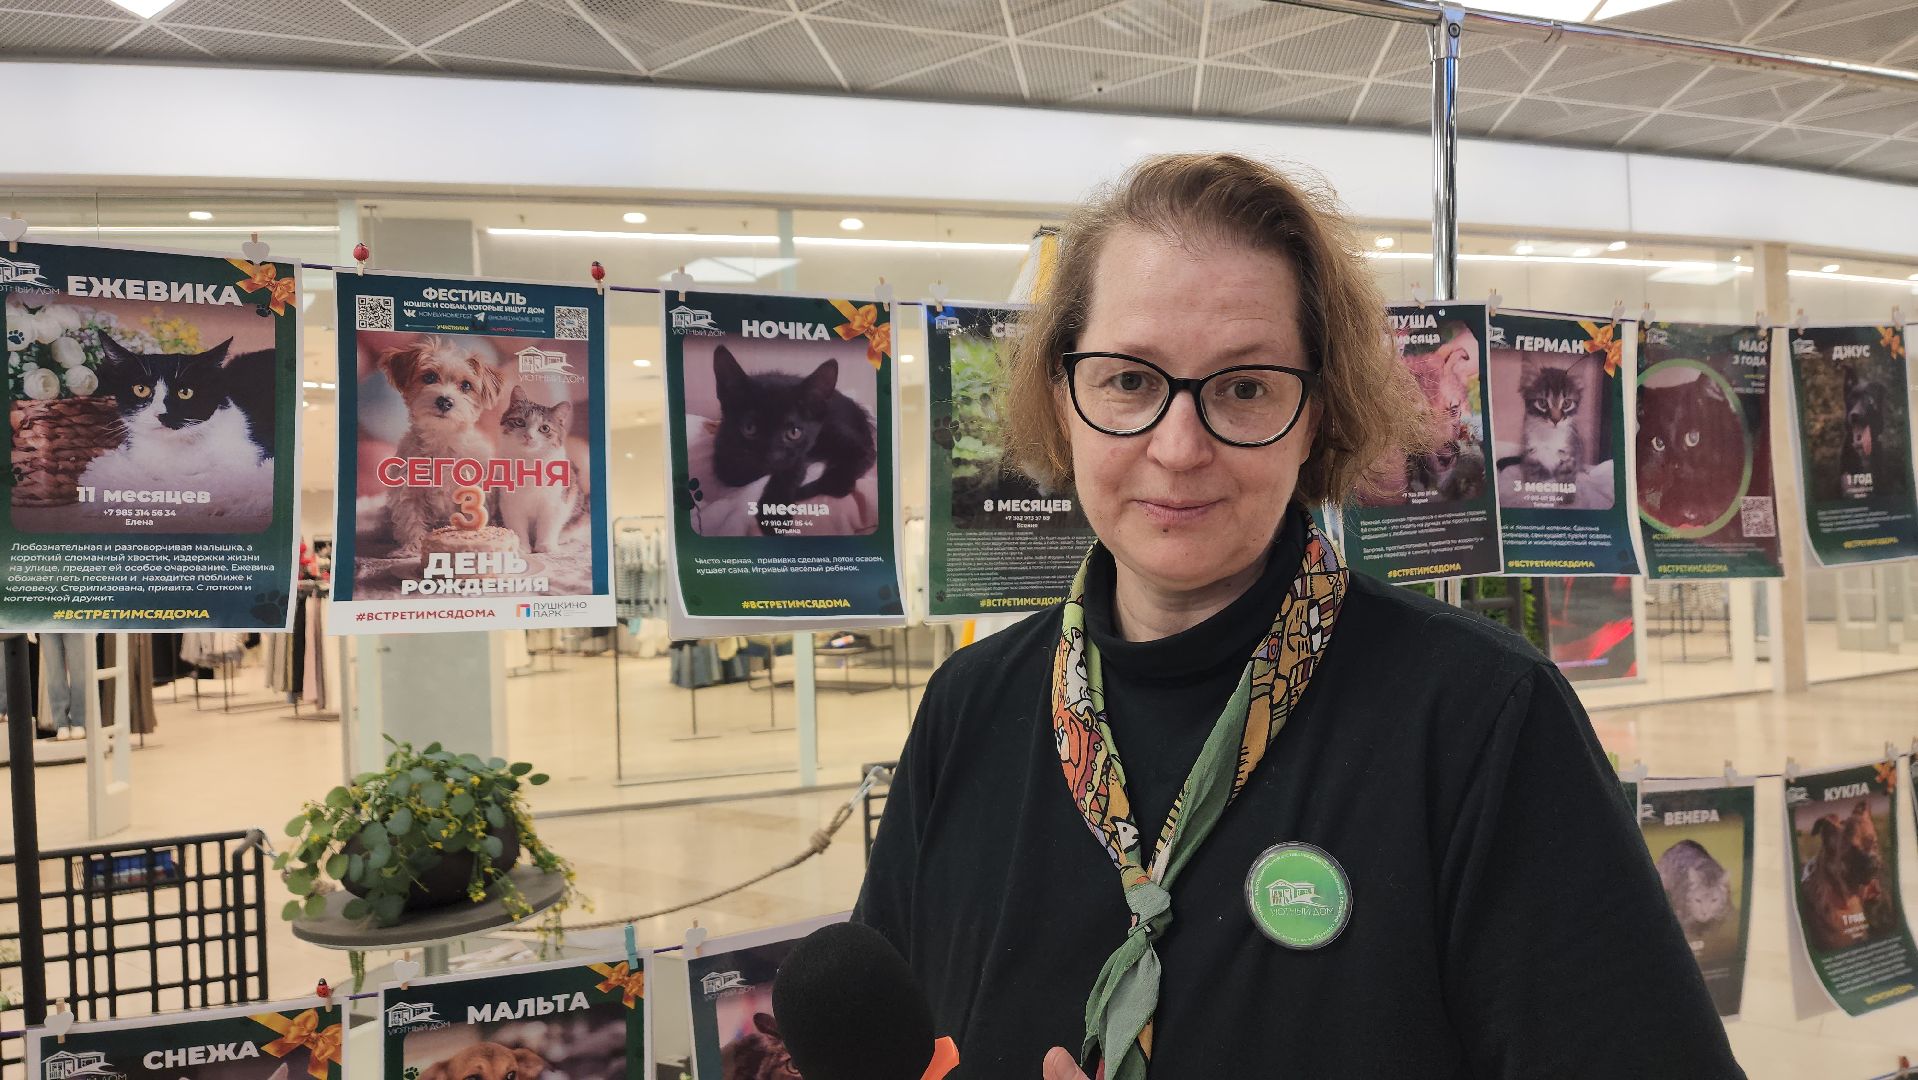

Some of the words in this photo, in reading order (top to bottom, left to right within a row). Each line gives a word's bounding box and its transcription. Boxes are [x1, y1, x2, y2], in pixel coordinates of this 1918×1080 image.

[67, 275, 244, 307] ЕЖЕВИКА
[422, 286, 528, 306] ФЕСТИВАЛЬ
[403, 300, 432, 308] КОШЕК
[467, 304, 504, 312] КОТОРЫЕ
[504, 306, 527, 314] ИЩУТ
[527, 307, 545, 315] ДОМ
[741, 319, 831, 341] НОЧКА
[1515, 334, 1586, 355] ГЕРМАН
[1738, 339, 1768, 353] МАО
[1831, 344, 1871, 361] ДЖУС
[1740, 354, 1768, 367] ГОДА
[376, 457, 571, 493] СЕГОДНЯ
[1853, 472, 1873, 486] ГОД
[1513, 480, 1522, 492] 3
[1524, 481, 1577, 494] месяца
[76, 486, 96, 503] 11
[103, 489, 212, 505] месяцев
[103, 508, 114, 516] +7
[115, 508, 134, 516] 985
[747, 501, 759, 516] 3
[762, 503, 830, 517] месяца
[983, 499, 994, 512] 8
[997, 499, 1072, 513] МЕСЯЦЕВ
[125, 518, 154, 526] Елена
[773, 527, 802, 535] Татьяна
[11, 543, 103, 552] Любознательная
[114, 544, 193, 553] разговорчивая
[10, 553, 62, 563] короткий
[64, 553, 126, 562] сломанный
[173, 554, 225, 563] издержки
[226, 554, 260, 562] жизни
[424, 551, 528, 578] ДЕНЬ
[694, 557, 721, 565] Чисто
[757, 556, 797, 565] прививка
[9, 564, 23, 572] на
[108, 563, 122, 572] ей
[124, 563, 163, 572] особое
[231, 563, 275, 572] Ежевика
[696, 566, 727, 575] кушает
[751, 564, 788, 574] Игривый
[7, 574, 54, 582] обожает
[56, 574, 81, 582] петь
[82, 574, 128, 582] песенки
[142, 574, 196, 583] находится
[197, 573, 245, 582] поближе
[196, 583, 204, 591] С
[205, 584, 243, 592] лотком
[401, 576, 549, 596] РОЖДЕНИЯ
[3, 594, 70, 603] когтеточкой
[533, 601, 588, 610] ПУШКИНО
[741, 598, 851, 609] #ВСТРЕТИМСЯДОМА
[979, 597, 1066, 608] #ВСТРЕТИМСЯДОМ
[53, 608, 210, 621] #ВСТРЕТИМСЯДОМА
[355, 608, 496, 622] #ВСТРЕТИМСЯДОМА
[533, 610, 562, 618] ПАРК
[1823, 782, 1871, 802] КУКЛА
[1664, 809, 1721, 827] ВЕНЕРА
[467, 991, 590, 1025] МАЛЬТА
[143, 1040, 260, 1071] СНЕЖА
